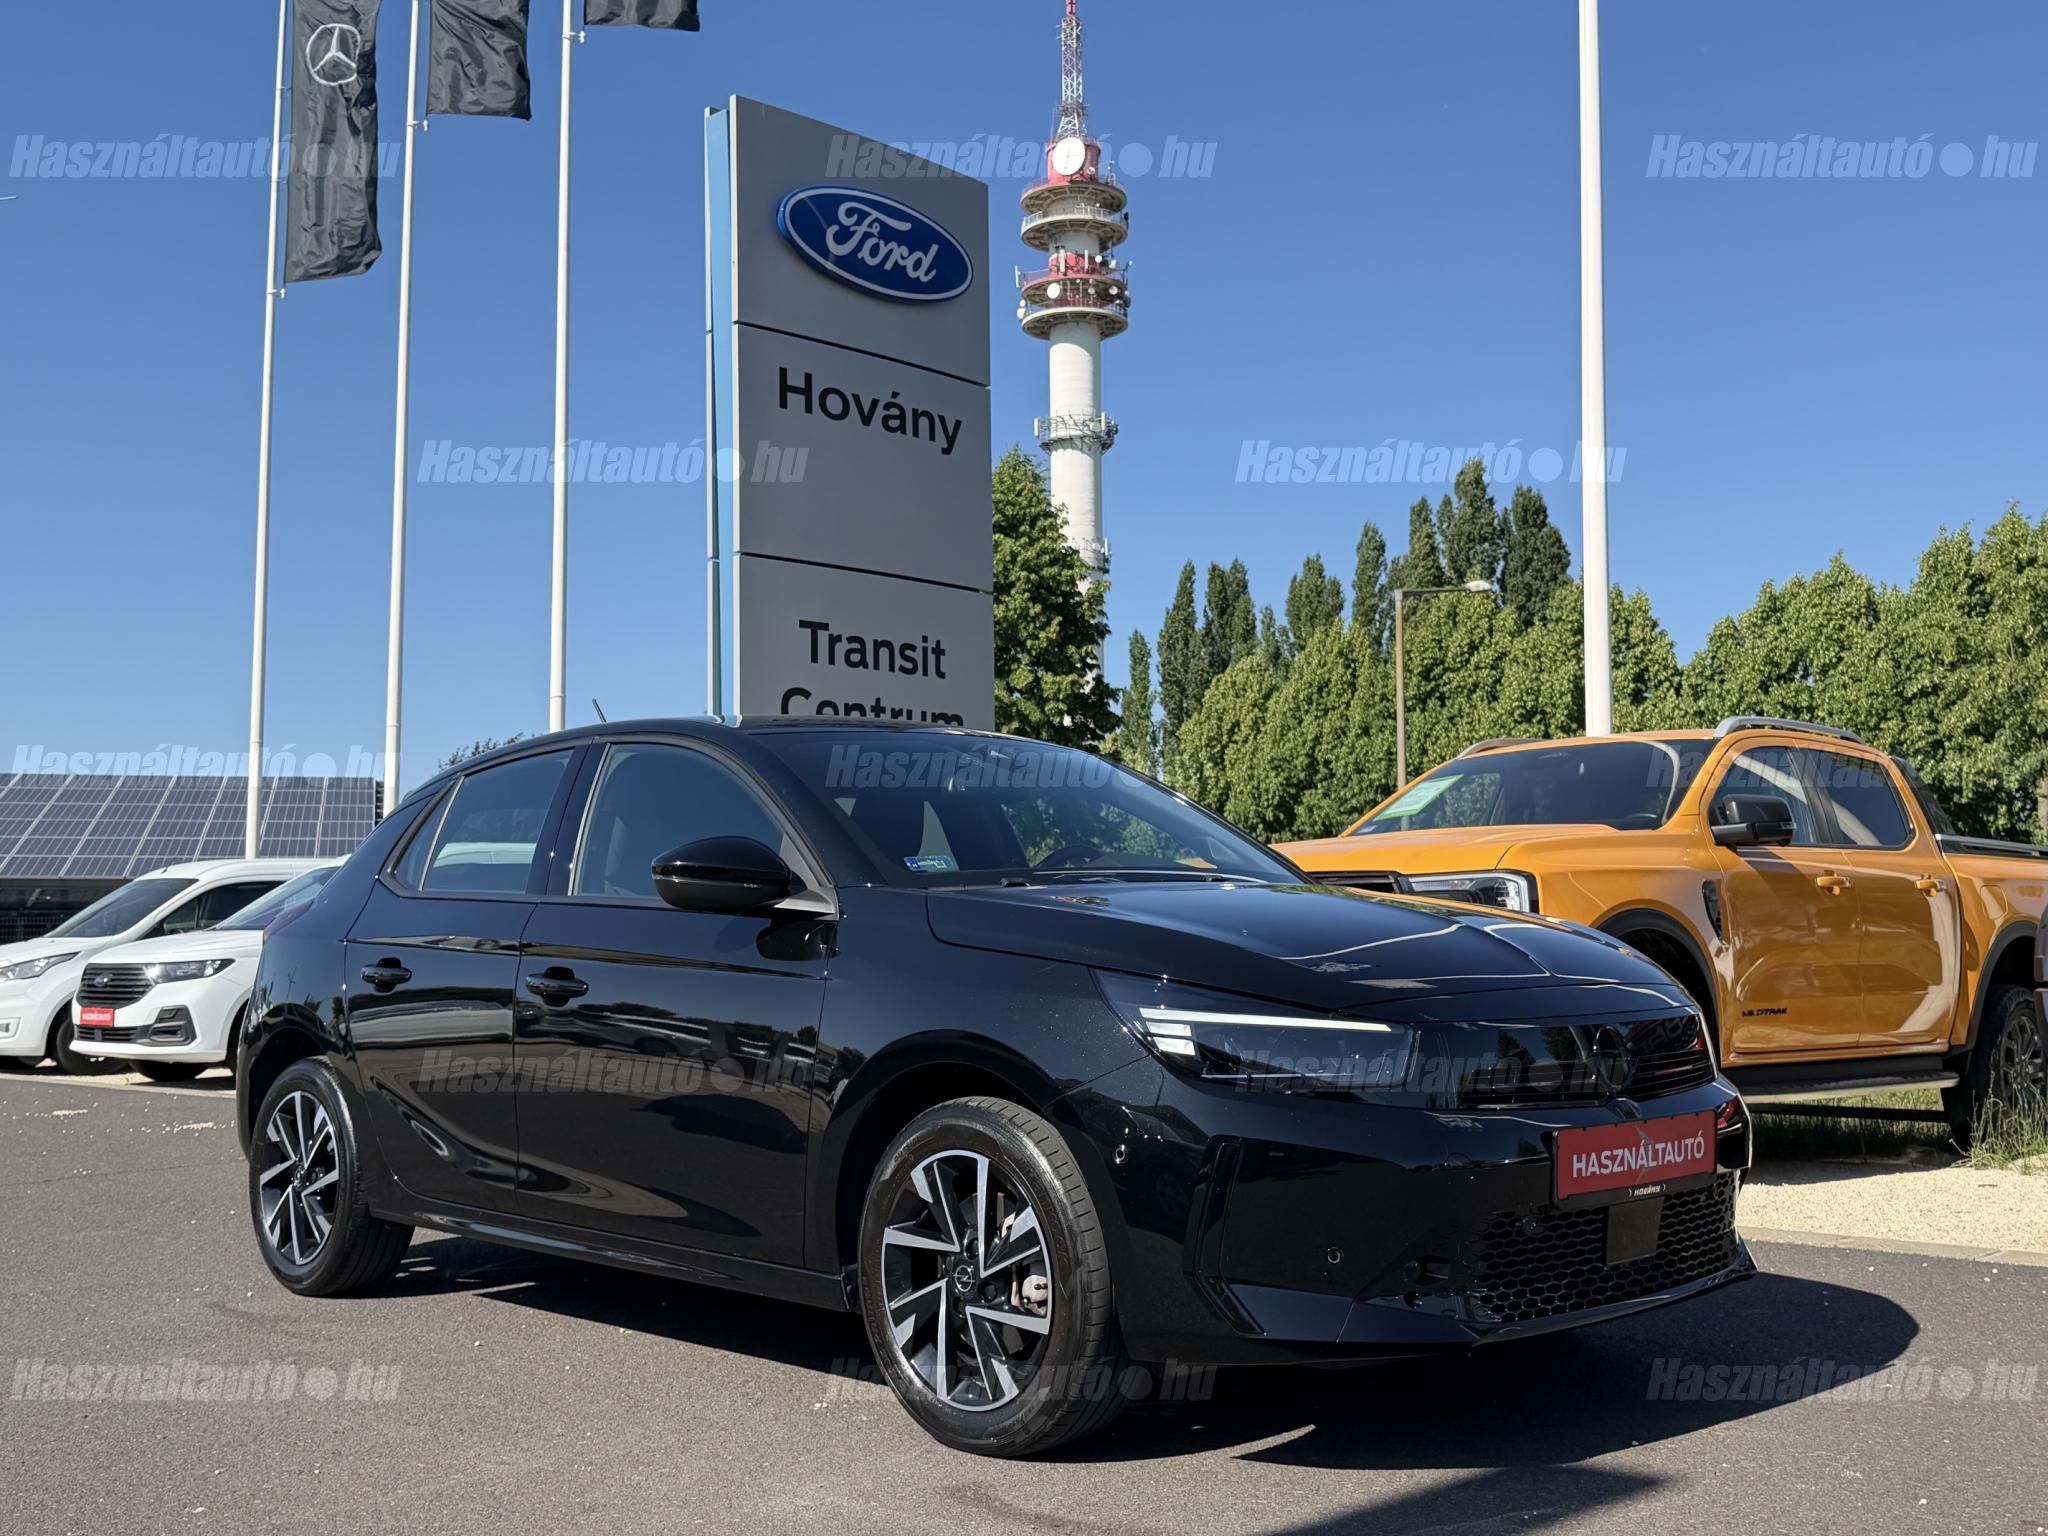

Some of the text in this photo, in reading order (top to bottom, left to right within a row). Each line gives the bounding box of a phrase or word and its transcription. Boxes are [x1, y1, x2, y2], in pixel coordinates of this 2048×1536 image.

[825, 201, 940, 283] Ford
[778, 366, 963, 455] Hovány
[798, 619, 946, 680] Transit
[1572, 1130, 1705, 1178] HASZNÁLTAUTÓ
